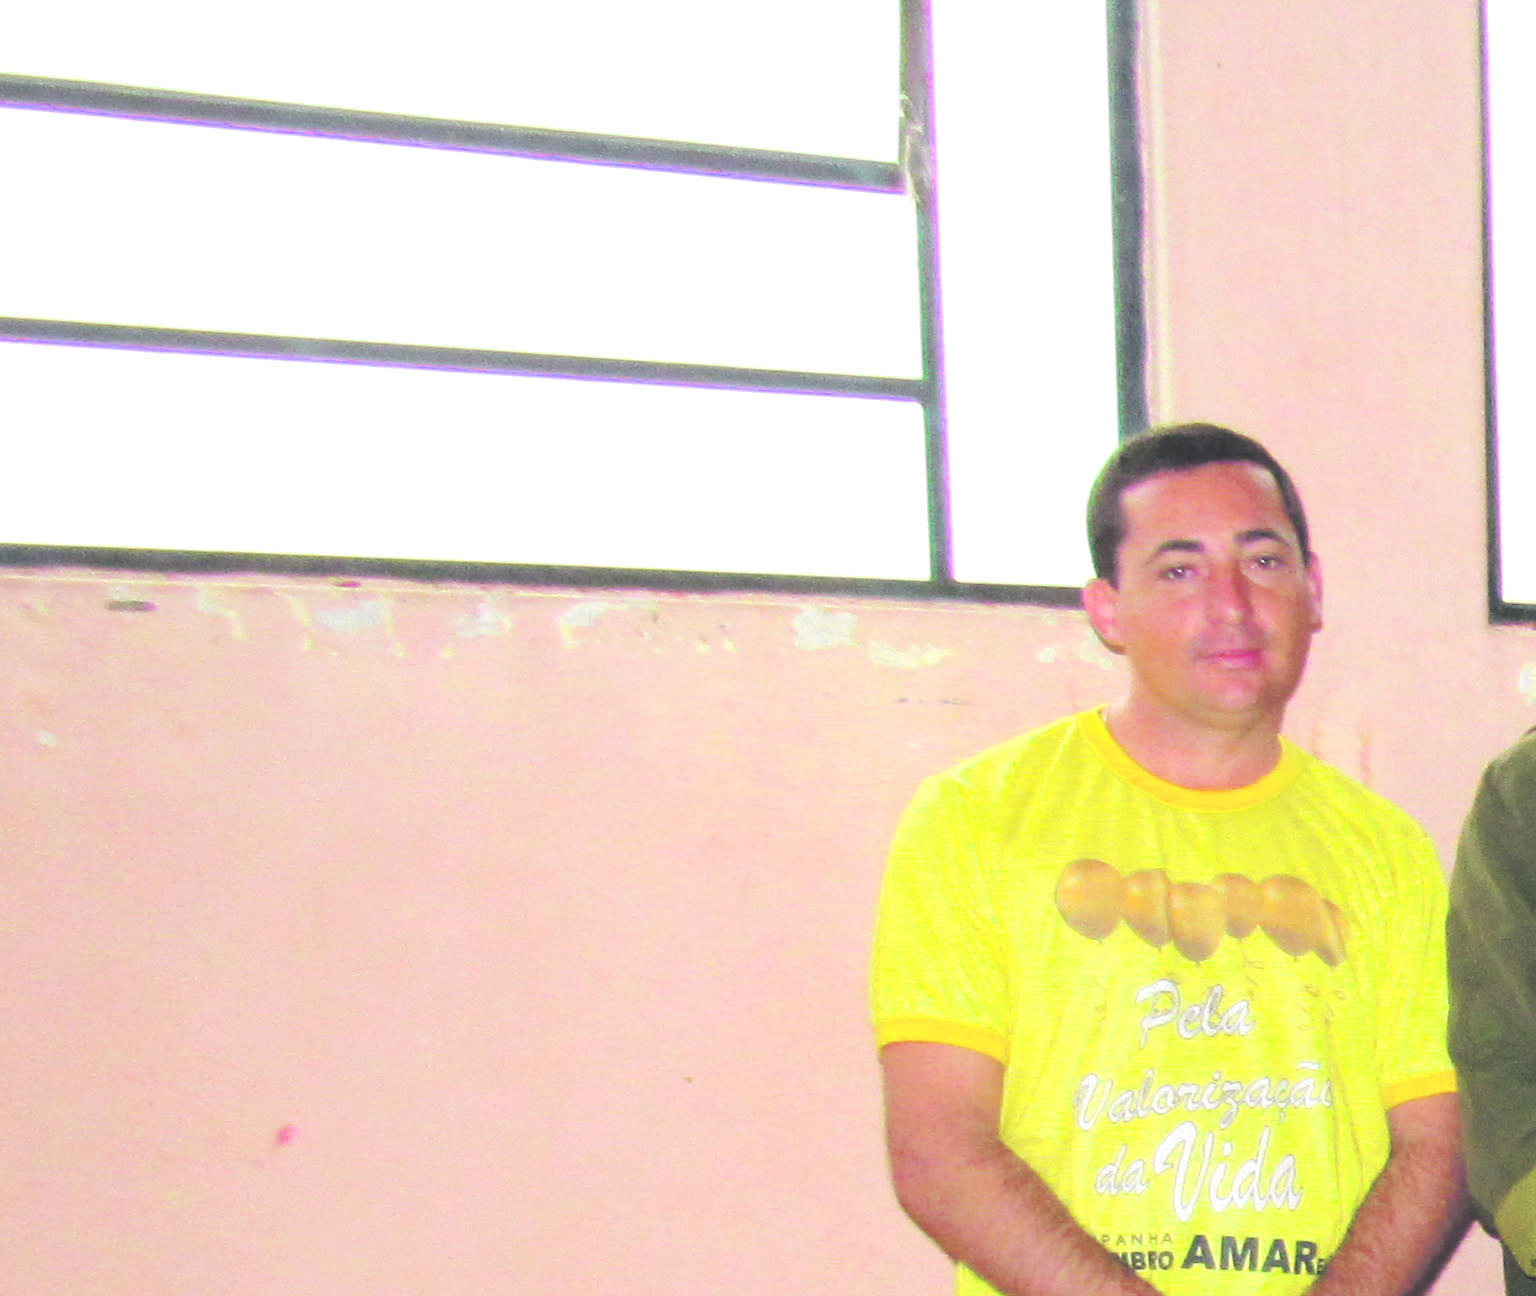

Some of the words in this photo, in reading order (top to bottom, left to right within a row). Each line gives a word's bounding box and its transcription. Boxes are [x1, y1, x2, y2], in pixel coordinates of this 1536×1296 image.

[1135, 979, 1256, 1049] Pela
[1095, 1143, 1150, 1195] da
[1152, 1121, 1304, 1223] Vida
